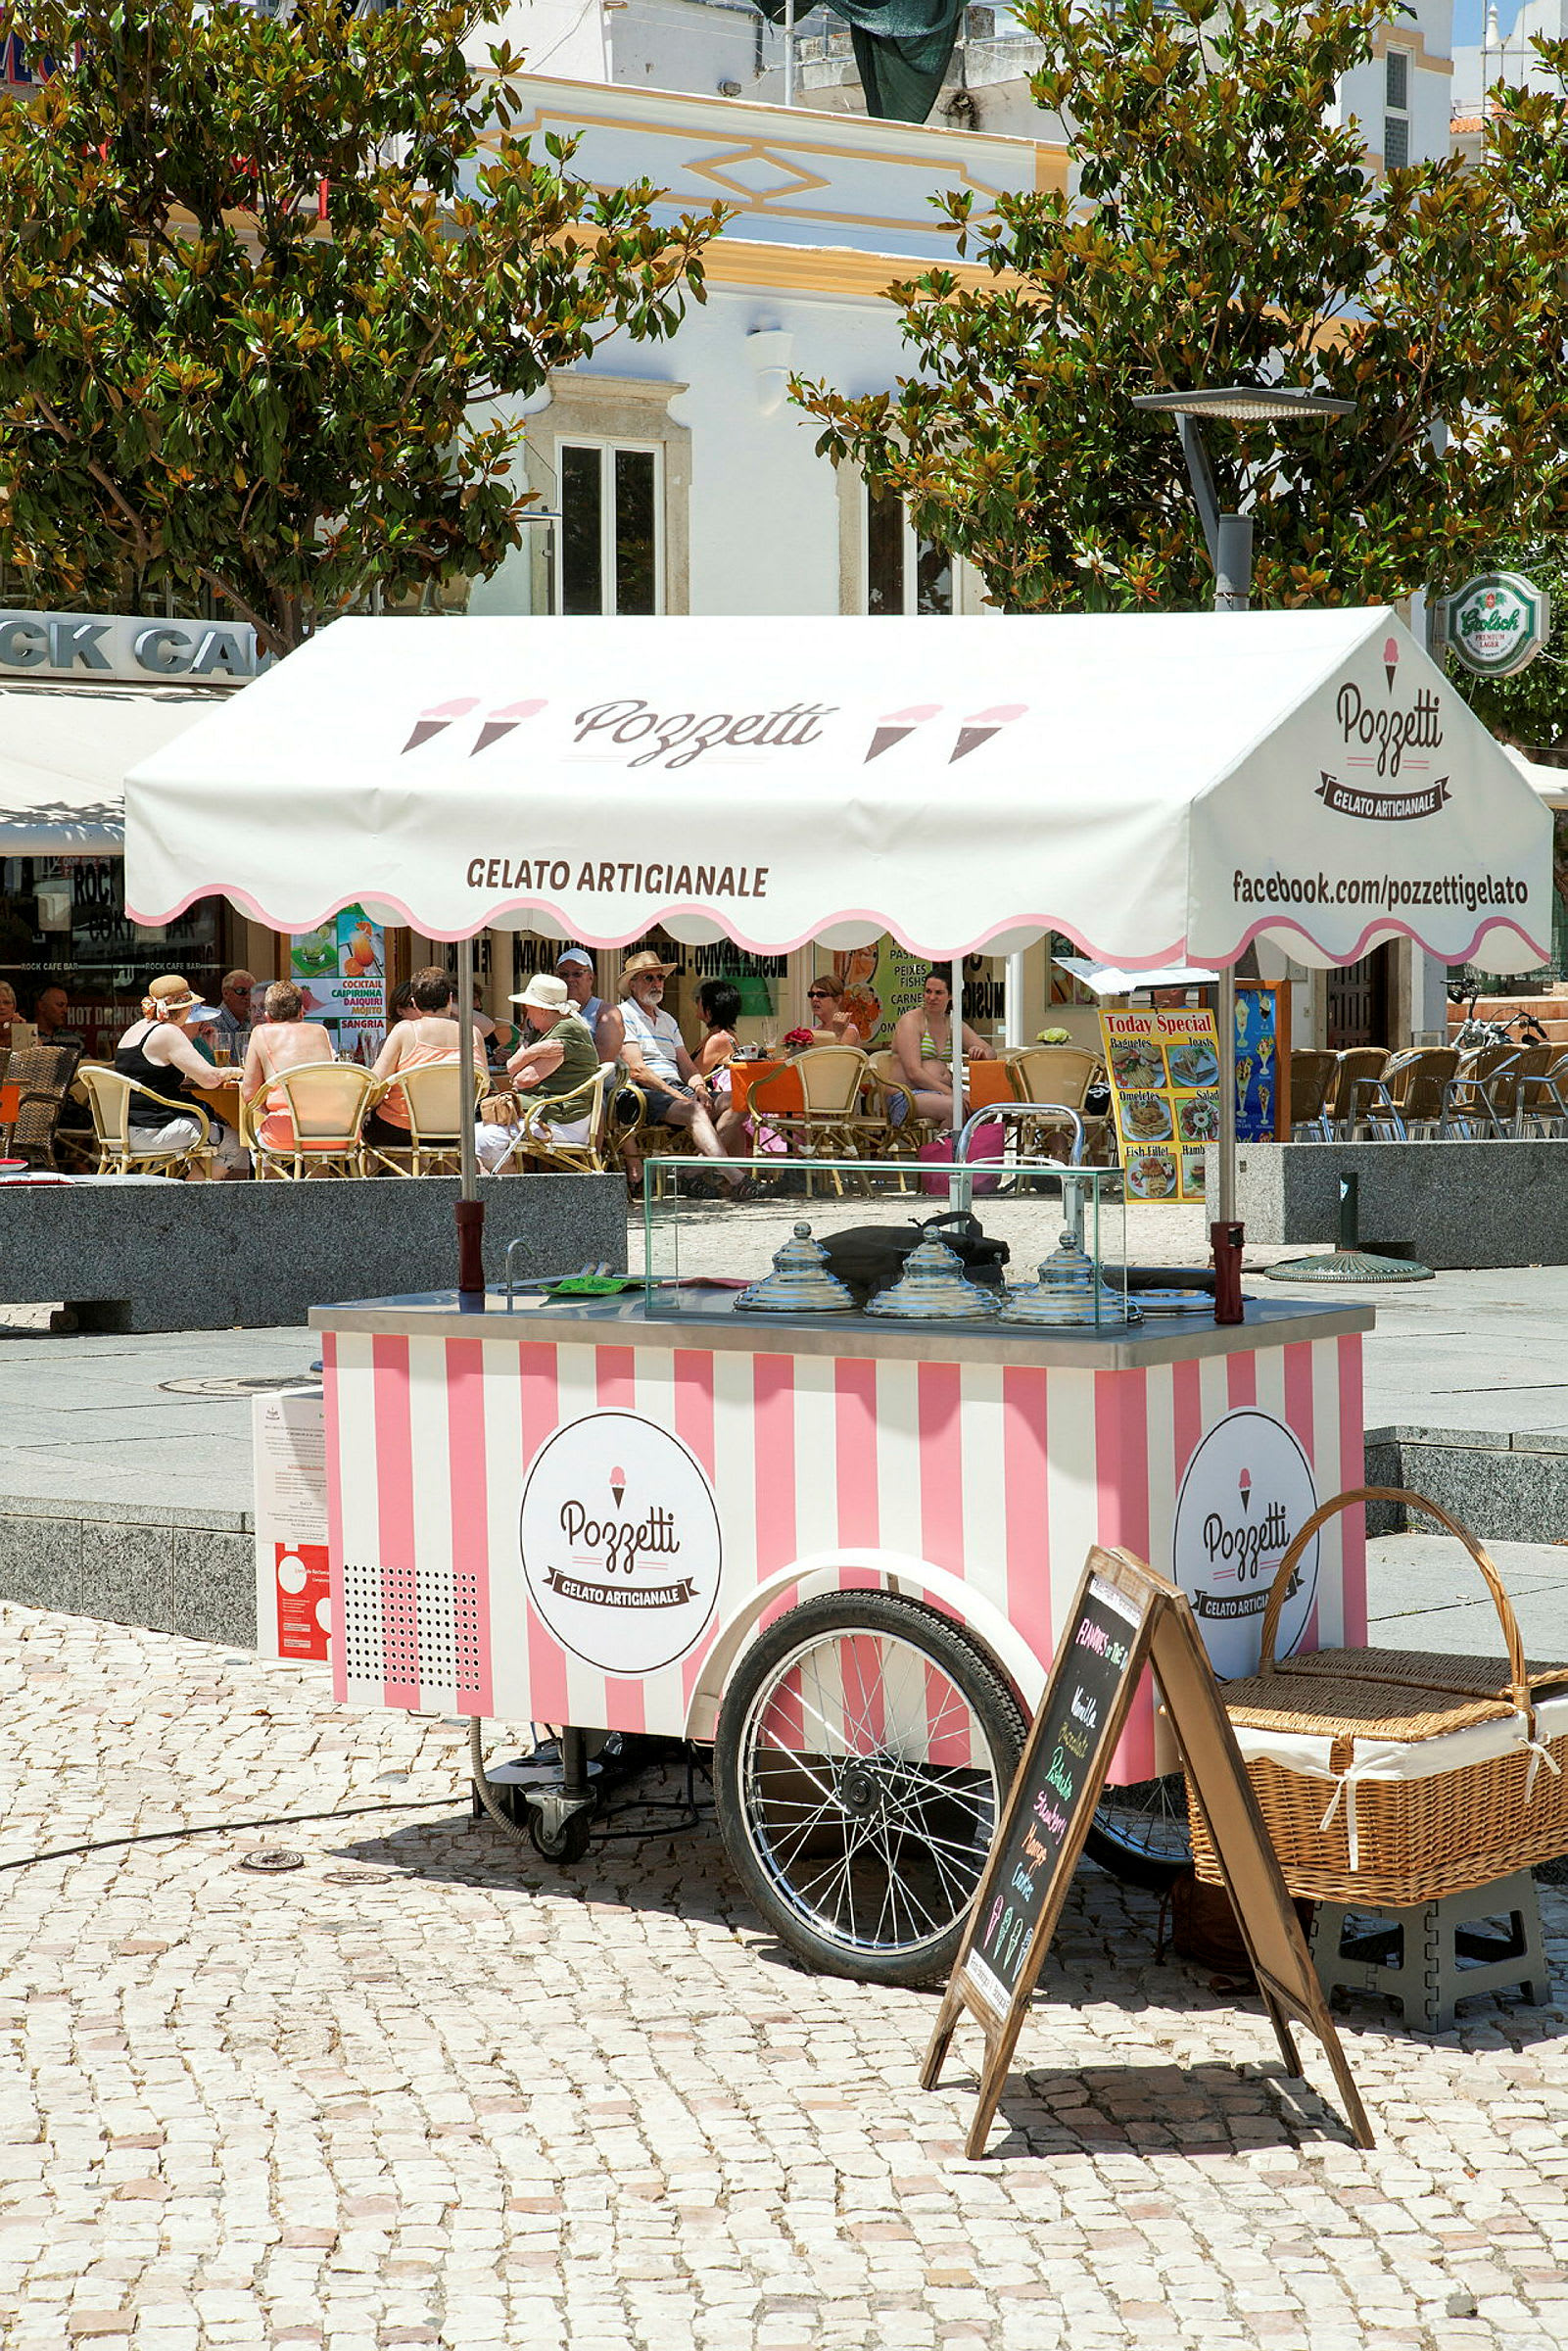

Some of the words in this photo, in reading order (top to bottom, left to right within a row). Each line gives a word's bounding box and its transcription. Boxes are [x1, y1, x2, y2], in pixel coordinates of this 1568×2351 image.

[1460, 607, 1520, 637] Grolsch
[0, 621, 113, 668] CK
[134, 629, 269, 676] CA
[574, 699, 841, 769] Pozzetti
[1337, 682, 1443, 778] Pozzetti
[1333, 789, 1372, 816] GELATO
[1375, 791, 1436, 817] ARTIGIANALE
[466, 858, 572, 890] GELATO
[576, 861, 770, 897] ARTIGIANALE
[1233, 869, 1528, 912] facebook.com/pozzettigelato
[21, 962, 45, 971] ROCK
[46, 962, 62, 971] CAFE
[64, 962, 79, 971] BAR
[894, 964, 927, 976] PEIXES
[344, 997, 382, 1006] DAIQUIRI
[890, 992, 924, 1004] CARNE
[68, 1006, 98, 1026] HOT
[341, 1019, 384, 1029] SANGRIA
[1105, 1015, 1152, 1035] Today
[1157, 1014, 1212, 1035] Special
[1111, 1037, 1152, 1049] Baguetes
[1188, 1037, 1215, 1047] Toasts
[1118, 1091, 1160, 1101] Omeletes
[1196, 1089, 1219, 1100] Salad
[1126, 1147, 1145, 1157] Fish
[1147, 1145, 1168, 1156] Fillet
[1181, 1144, 1206, 1155] Hamb
[560, 1500, 680, 1574] Pozzetti
[1204, 1502, 1290, 1582] Pozzetti
[561, 1581, 605, 1602] GELATO
[605, 1589, 680, 1607] ARTIGIANALE
[1206, 1600, 1237, 1616] GELATO
[1022, 1822, 1048, 1878] Mango
